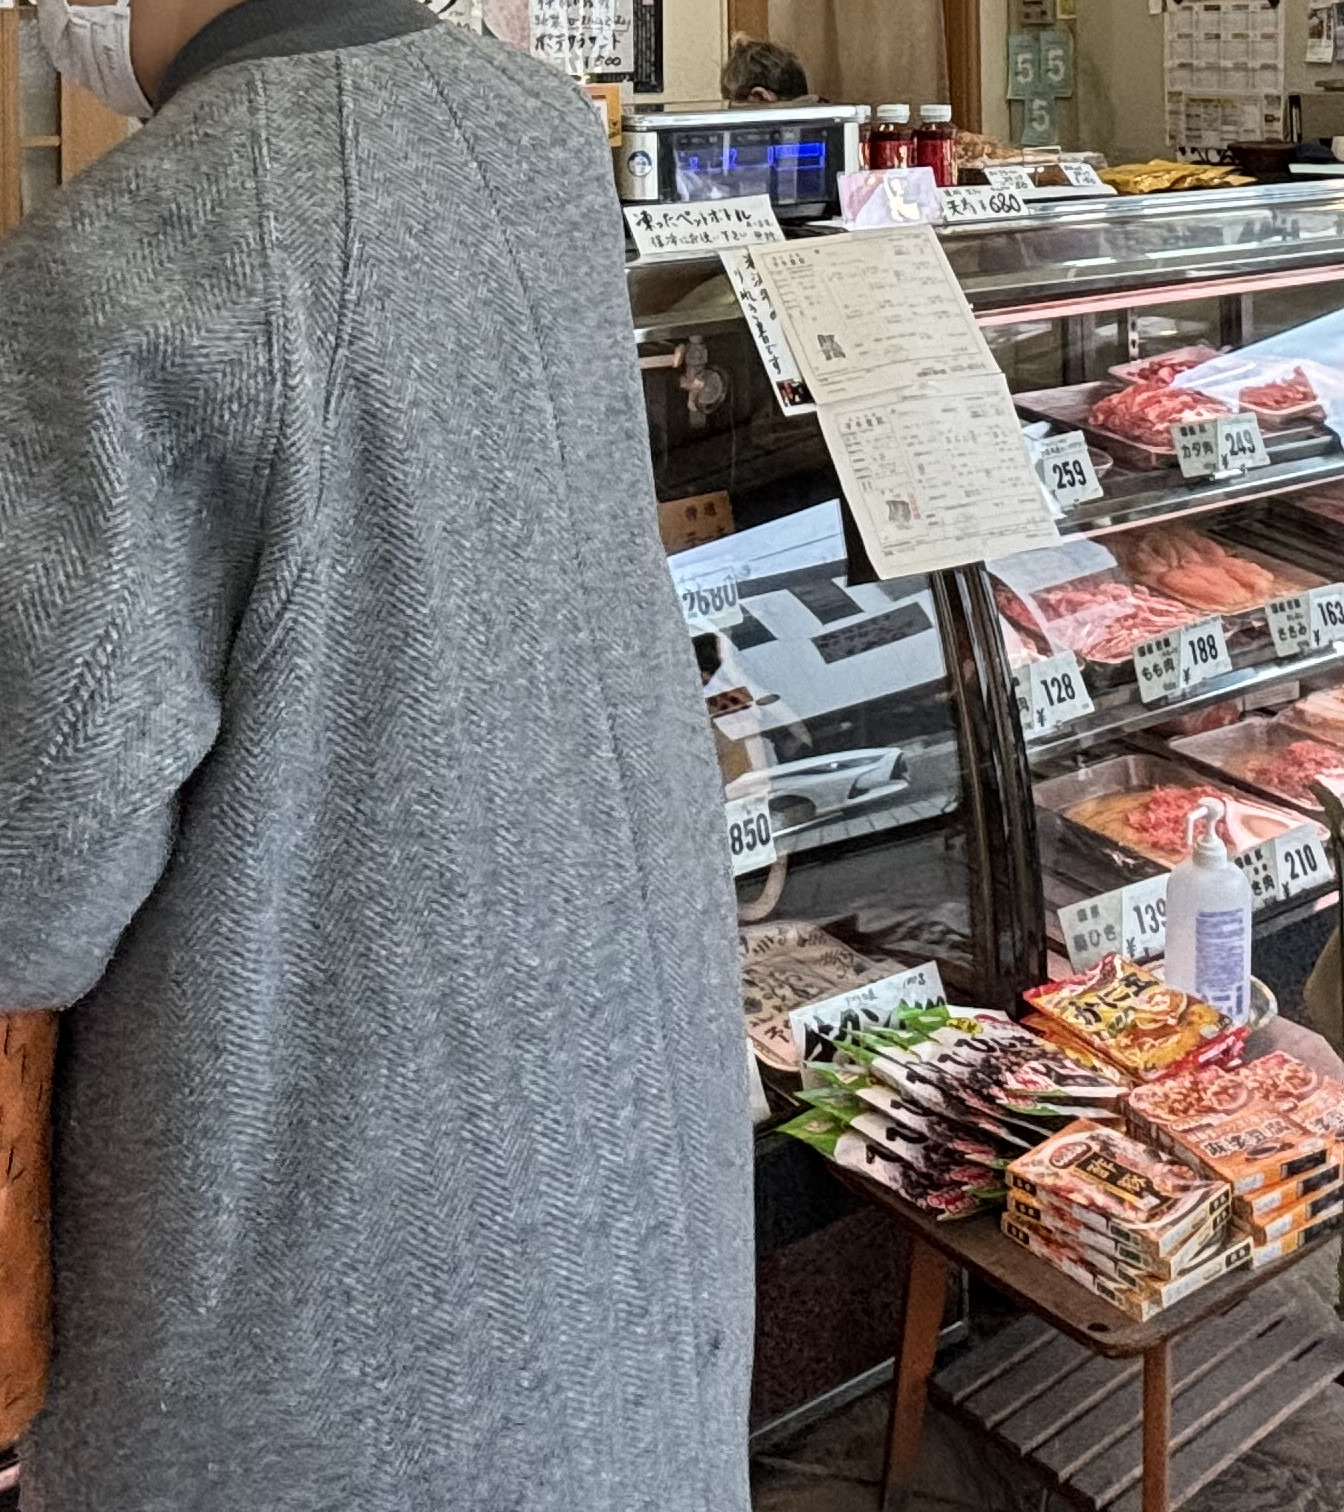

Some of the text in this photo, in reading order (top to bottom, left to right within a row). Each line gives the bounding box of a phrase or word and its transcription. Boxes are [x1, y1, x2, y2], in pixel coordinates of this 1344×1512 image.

[1016, 52, 1034, 85] 5
[1048, 48, 1066, 83] 5
[1031, 98, 1051, 132] 5
[988, 192, 1022, 214] 680
[1052, 459, 1088, 490] 259
[1187, 633, 1218, 666] 188
[1141, 657, 1176, 682] もも肉
[1040, 672, 1077, 708] 128
[729, 812, 771, 856] 850
[1284, 844, 1319, 881] 210
